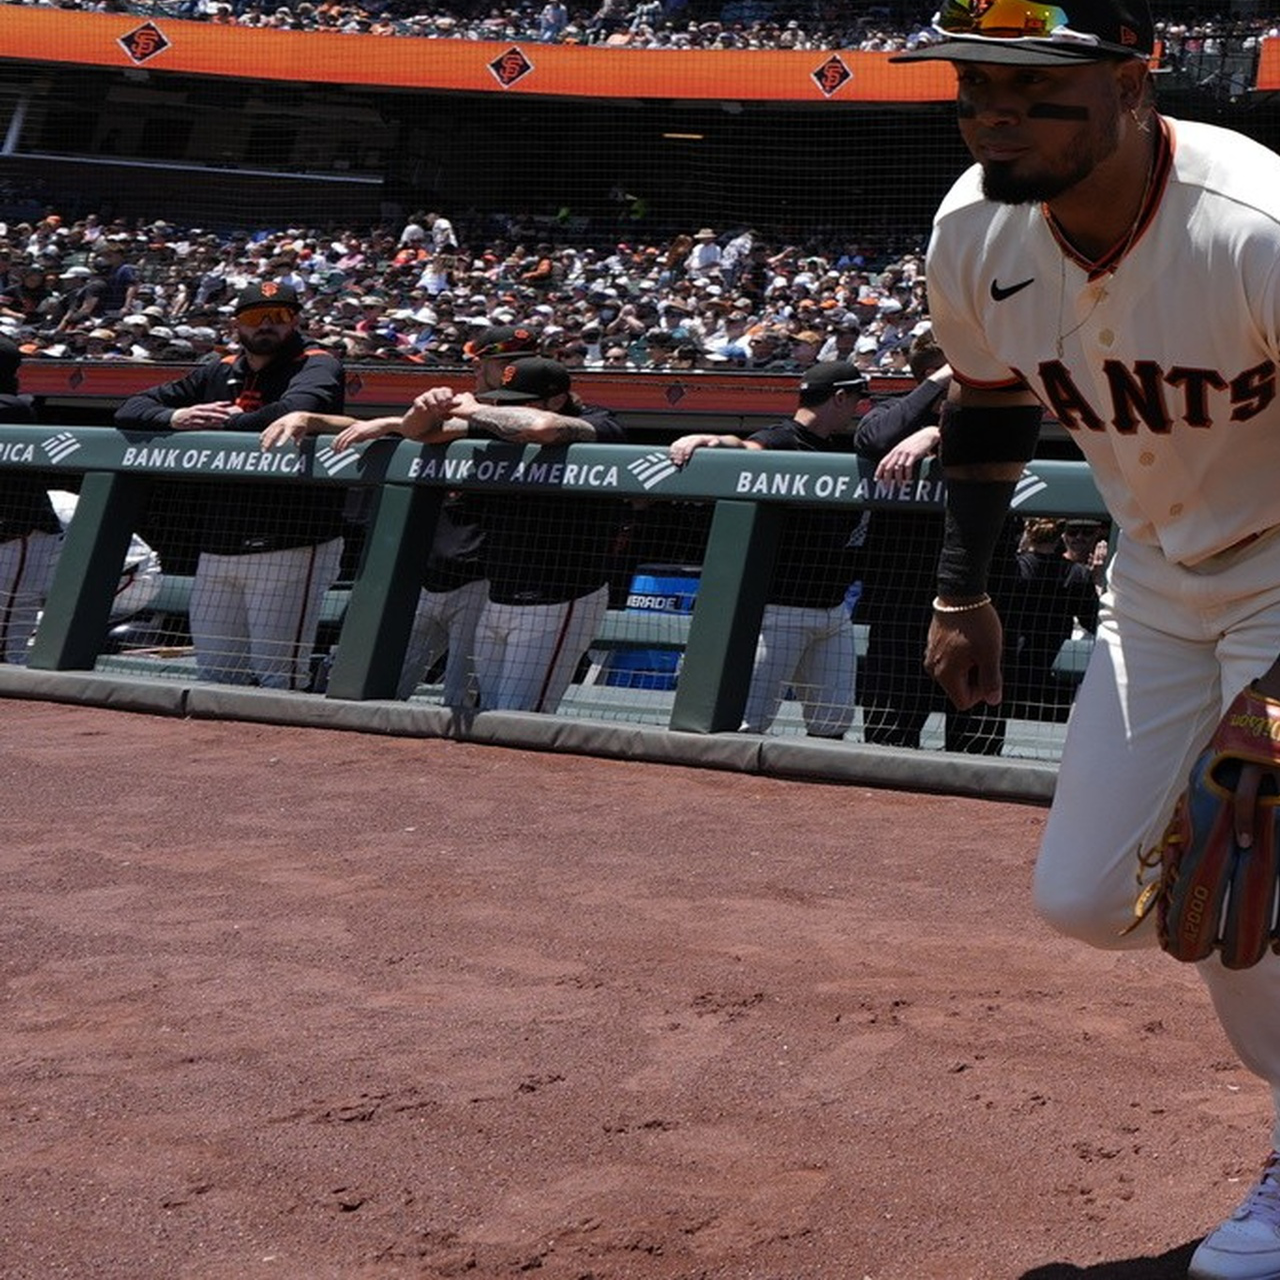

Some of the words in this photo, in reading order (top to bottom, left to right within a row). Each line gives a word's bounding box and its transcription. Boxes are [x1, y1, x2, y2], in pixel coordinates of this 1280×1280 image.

[1024, 358, 1278, 435] ANTS
[121, 447, 181, 468] BANK
[181, 449, 212, 469] OF
[211, 449, 306, 474] AMERICA
[407, 458, 475, 480] BANK
[476, 460, 510, 481] OF
[510, 461, 619, 487] AMERICA
[736, 471, 810, 497] BANK
[813, 475, 850, 499] OF
[853, 477, 947, 502] AMERI
